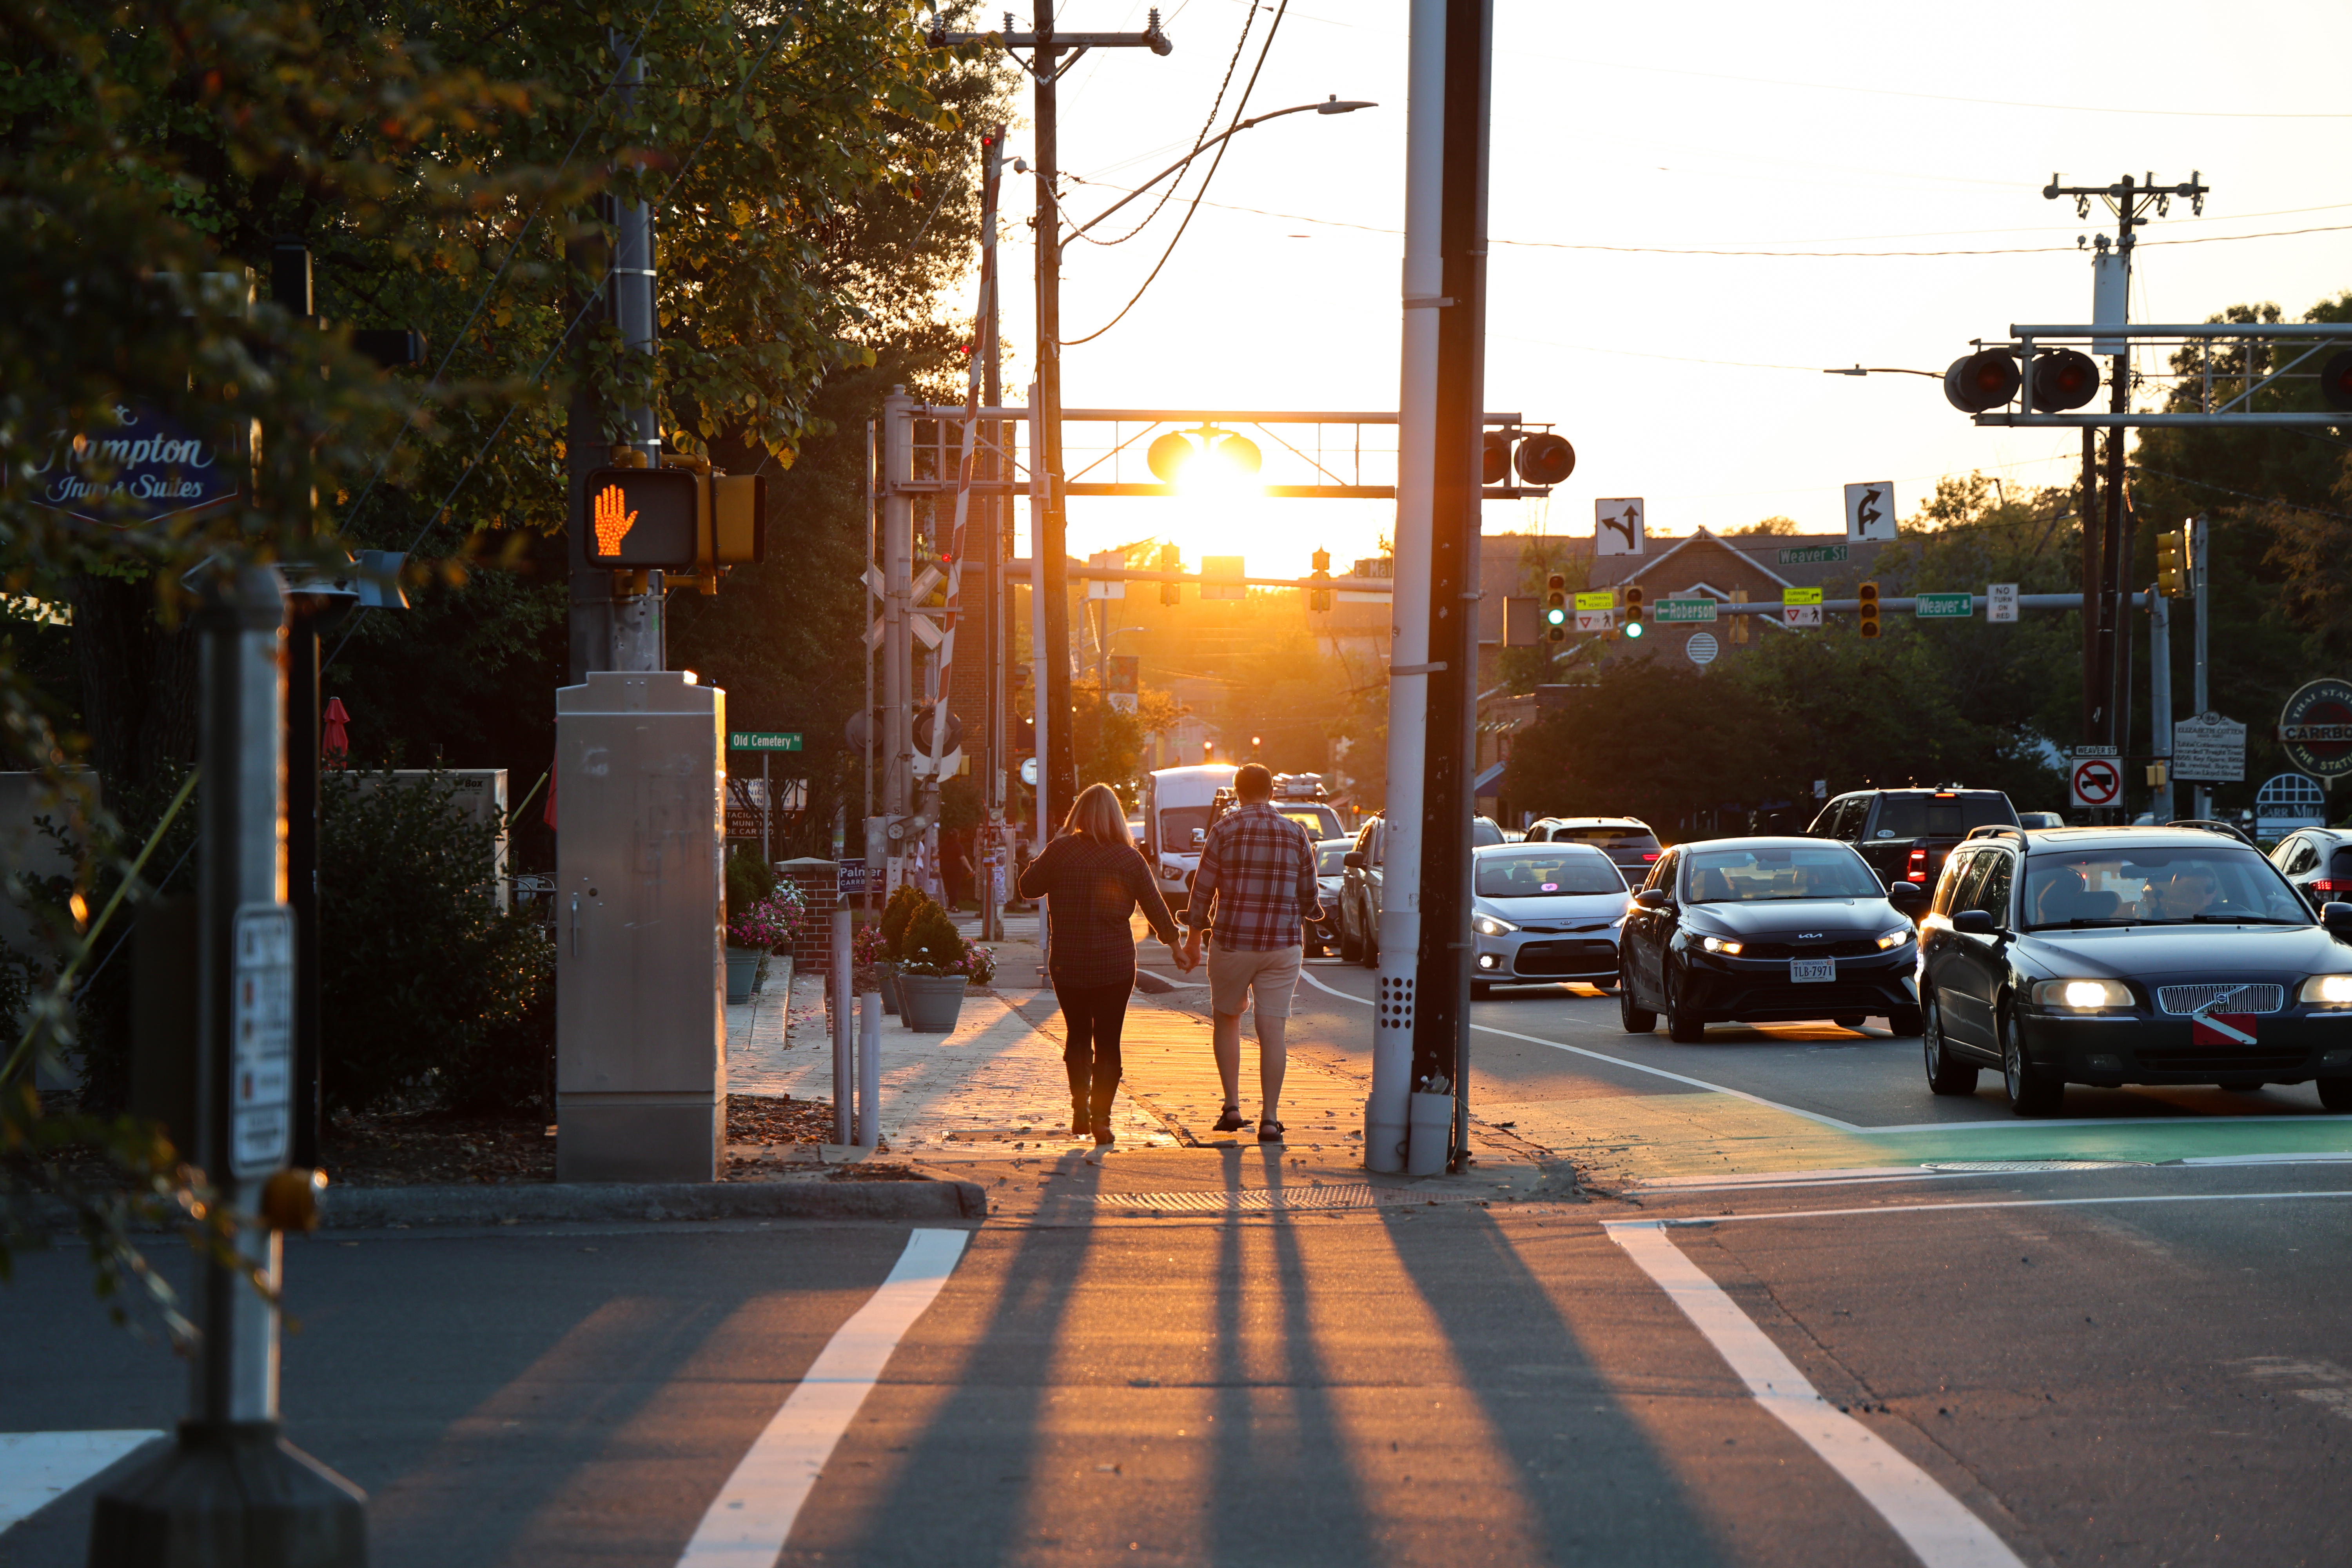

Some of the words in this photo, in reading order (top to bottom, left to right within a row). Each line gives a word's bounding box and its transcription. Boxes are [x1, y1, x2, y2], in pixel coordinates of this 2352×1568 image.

[130, 474, 202, 499] Suites
[1780, 550, 1827, 563] Weaver
[1832, 546, 1847, 561] St
[1356, 561, 1363, 577] E
[1369, 561, 1392, 577] Mai
[1669, 602, 1714, 618] Roberson
[1918, 597, 1960, 613] Weaver
[2292, 693, 2316, 719] THAI
[2285, 727, 2352, 739] CARRBO
[733, 734, 748, 746] Old
[751, 735, 791, 749] Cemetery
[2296, 744, 2314, 766] THE
[2319, 751, 2352, 771] STATI
[1794, 965, 1833, 977] TLB-7971
